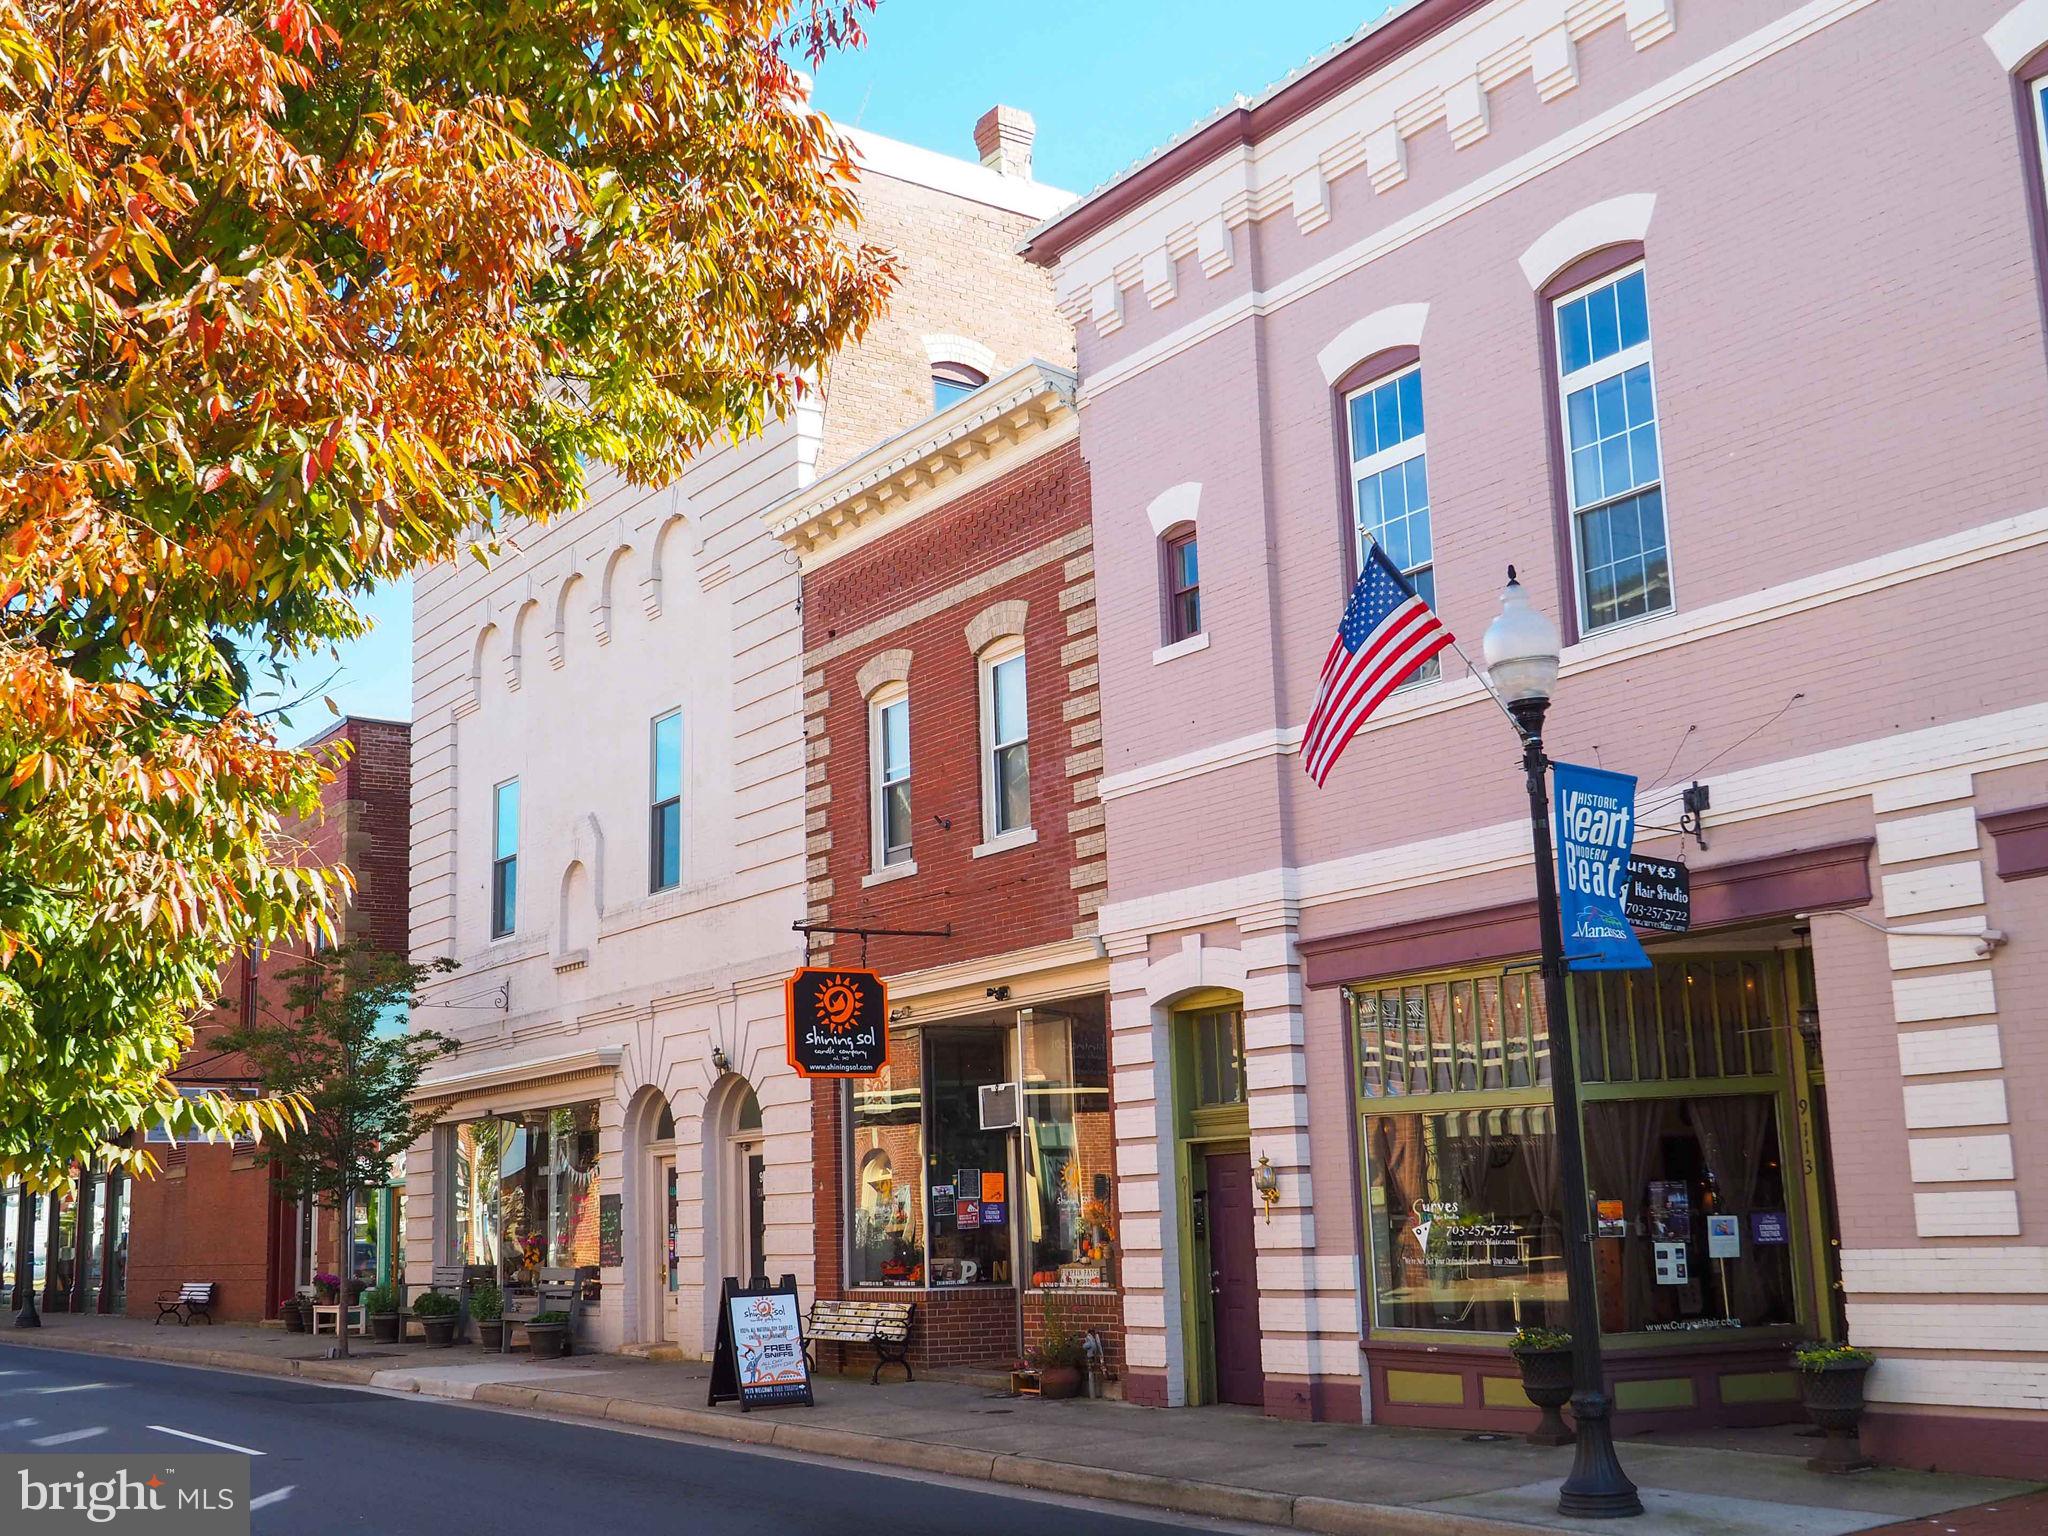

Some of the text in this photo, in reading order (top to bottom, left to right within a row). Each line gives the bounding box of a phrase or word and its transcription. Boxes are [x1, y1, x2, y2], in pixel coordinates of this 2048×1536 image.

[1578, 794, 1618, 810] HISTORIC
[1562, 789, 1630, 849] Heart
[1575, 845, 1609, 862] MODERN
[1565, 841, 1621, 899] Beat
[1626, 860, 1676, 879] urves
[1635, 881, 1688, 904] Hair Studio
[1626, 902, 1688, 922] 703-257-5722
[1574, 921, 1627, 939] Manassas
[805, 1026, 875, 1050] shining sol
[838, 1049, 868, 1060] company
[809, 1063, 873, 1072] www.shiningsol.com
[1446, 1225, 1515, 1237] 703-257-5722
[774, 1304, 786, 1317] sol
[764, 1343, 793, 1352] FREE
